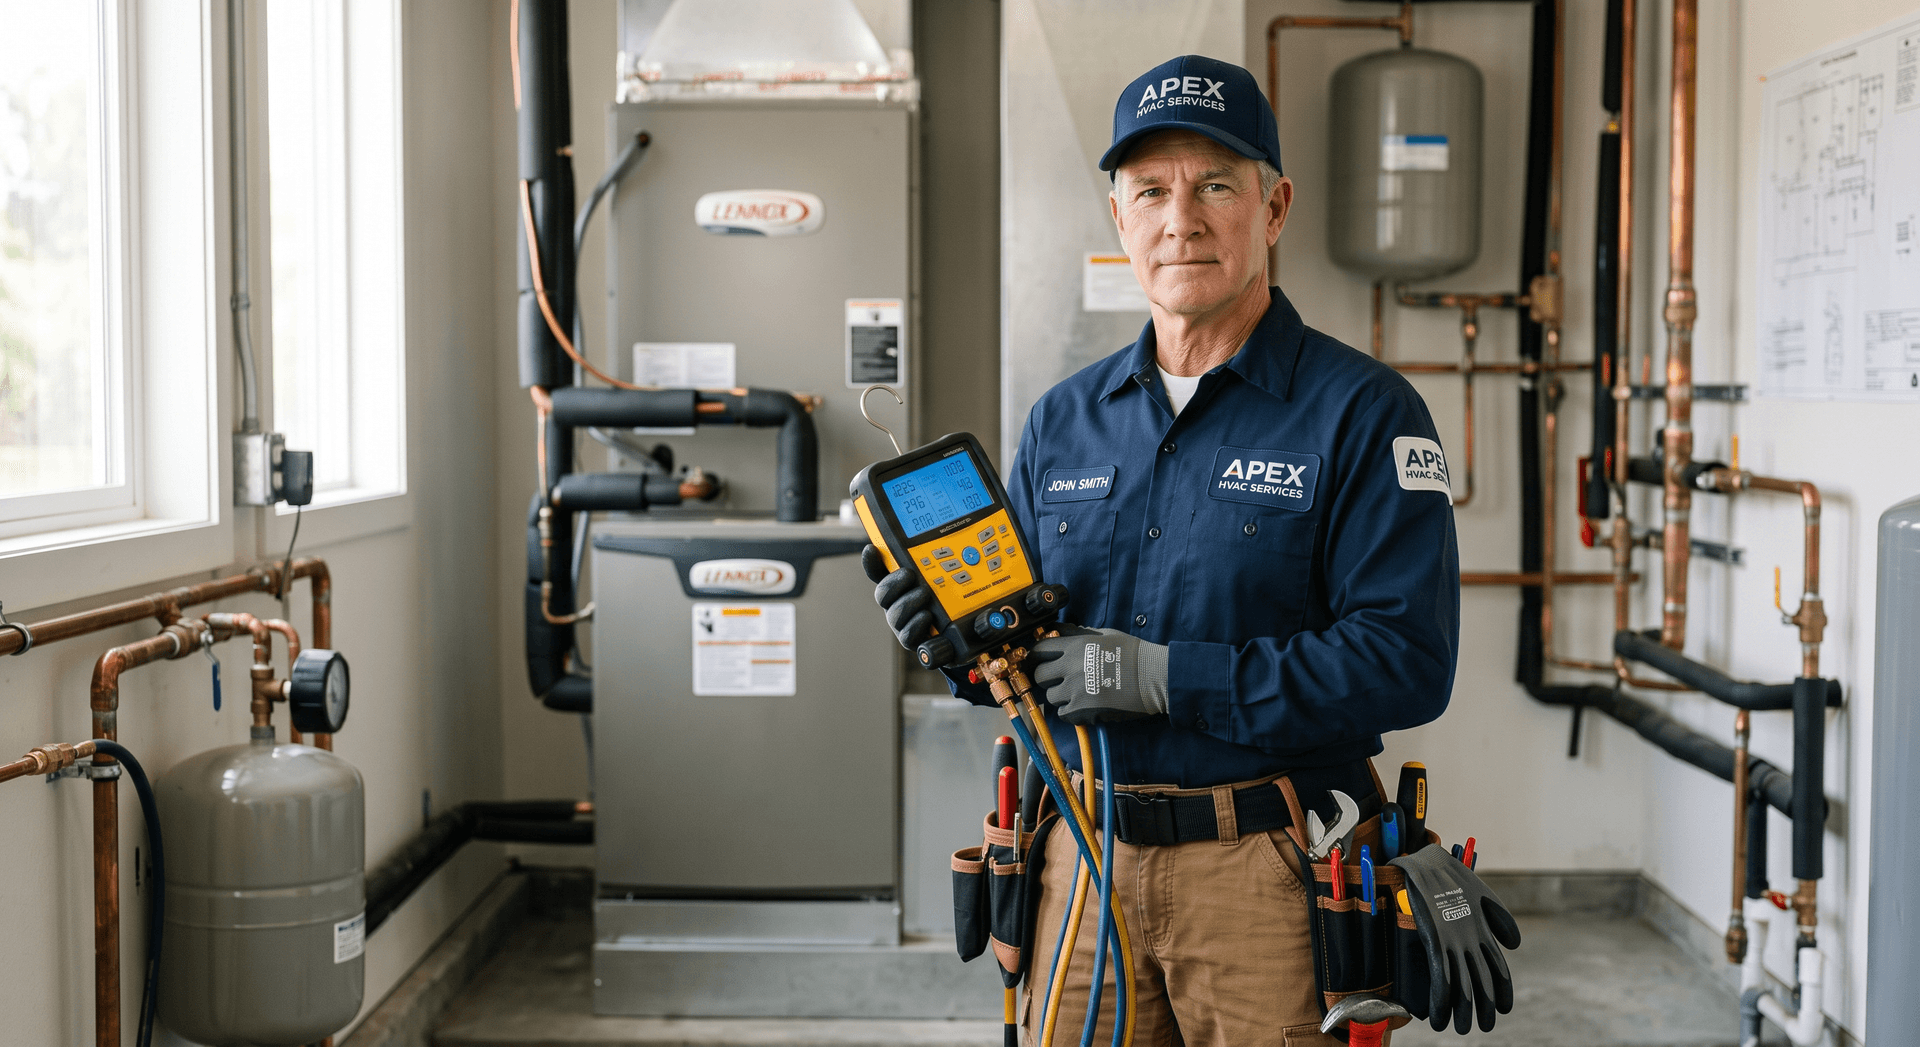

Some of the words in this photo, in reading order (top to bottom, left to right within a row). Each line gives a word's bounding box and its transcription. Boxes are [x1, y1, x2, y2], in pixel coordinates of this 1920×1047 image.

[1138, 76, 1225, 108] APEX
[1136, 100, 1164, 118] HVAC
[1167, 97, 1226, 112] SERVICES
[1405, 448, 1447, 476] APE
[1221, 458, 1308, 488] APEX
[1405, 470, 1432, 479] HVAC
[1048, 479, 1077, 492] JOHN
[1078, 476, 1110, 490] SMITH
[1218, 480, 1248, 492] HVAC
[1249, 483, 1304, 500] SERVICES
